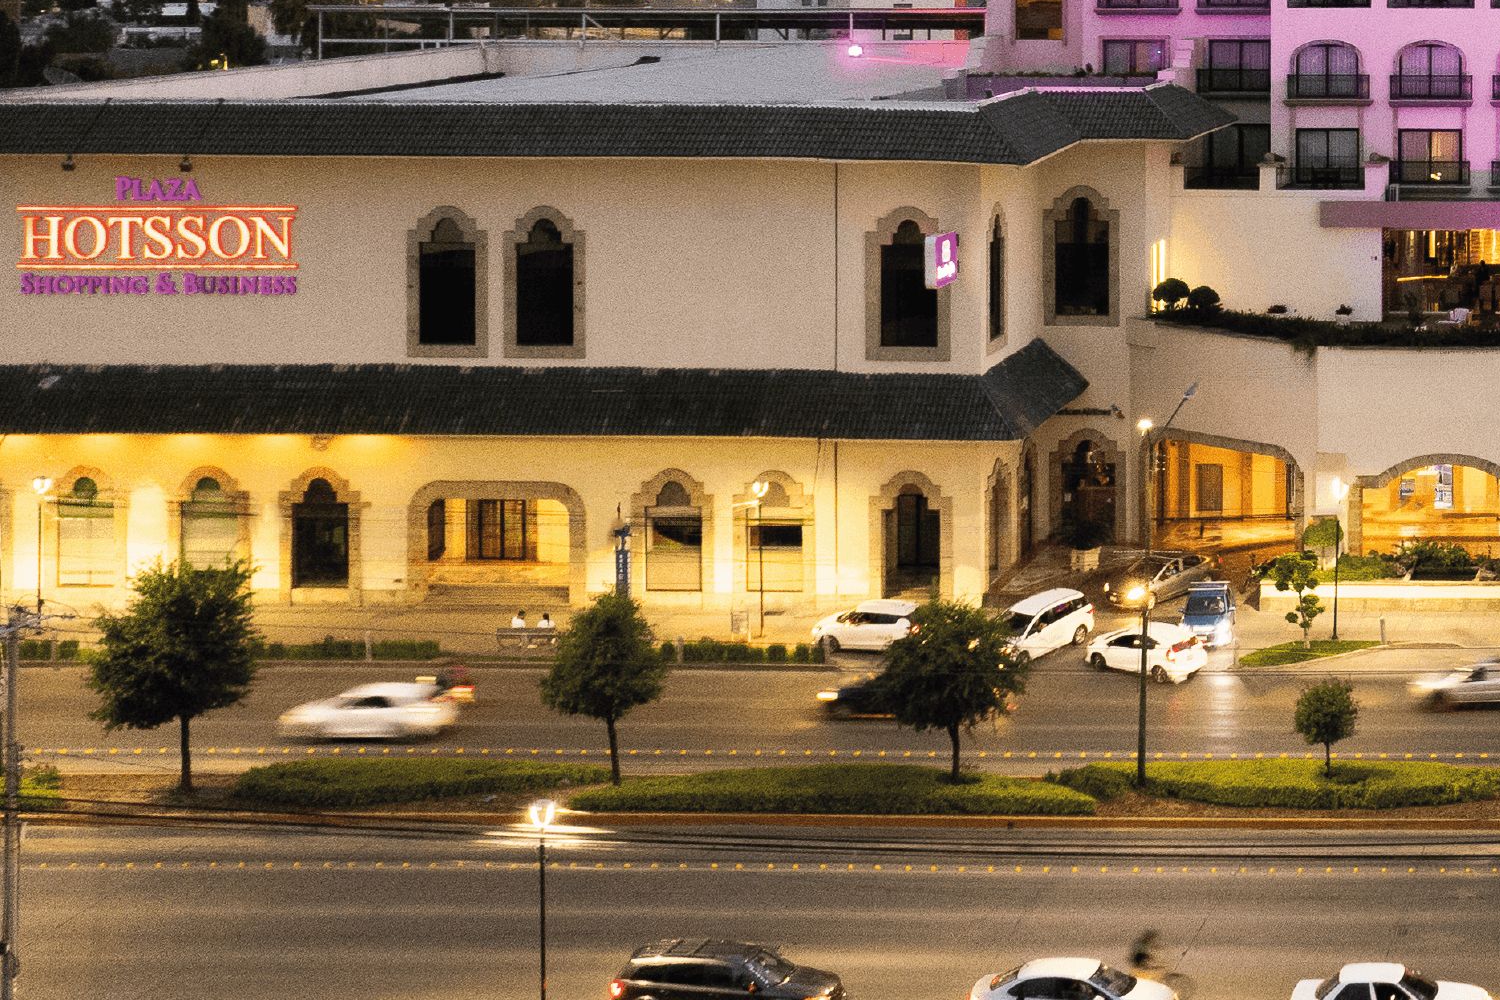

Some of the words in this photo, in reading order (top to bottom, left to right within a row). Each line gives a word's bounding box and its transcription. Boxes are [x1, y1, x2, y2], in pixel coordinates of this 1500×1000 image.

[115, 176, 201, 201] PLAZA
[21, 215, 294, 261] HOTSSON
[20, 272, 150, 296] SHOPPING
[154, 272, 179, 296] &
[182, 273, 298, 296] BUSINESS
